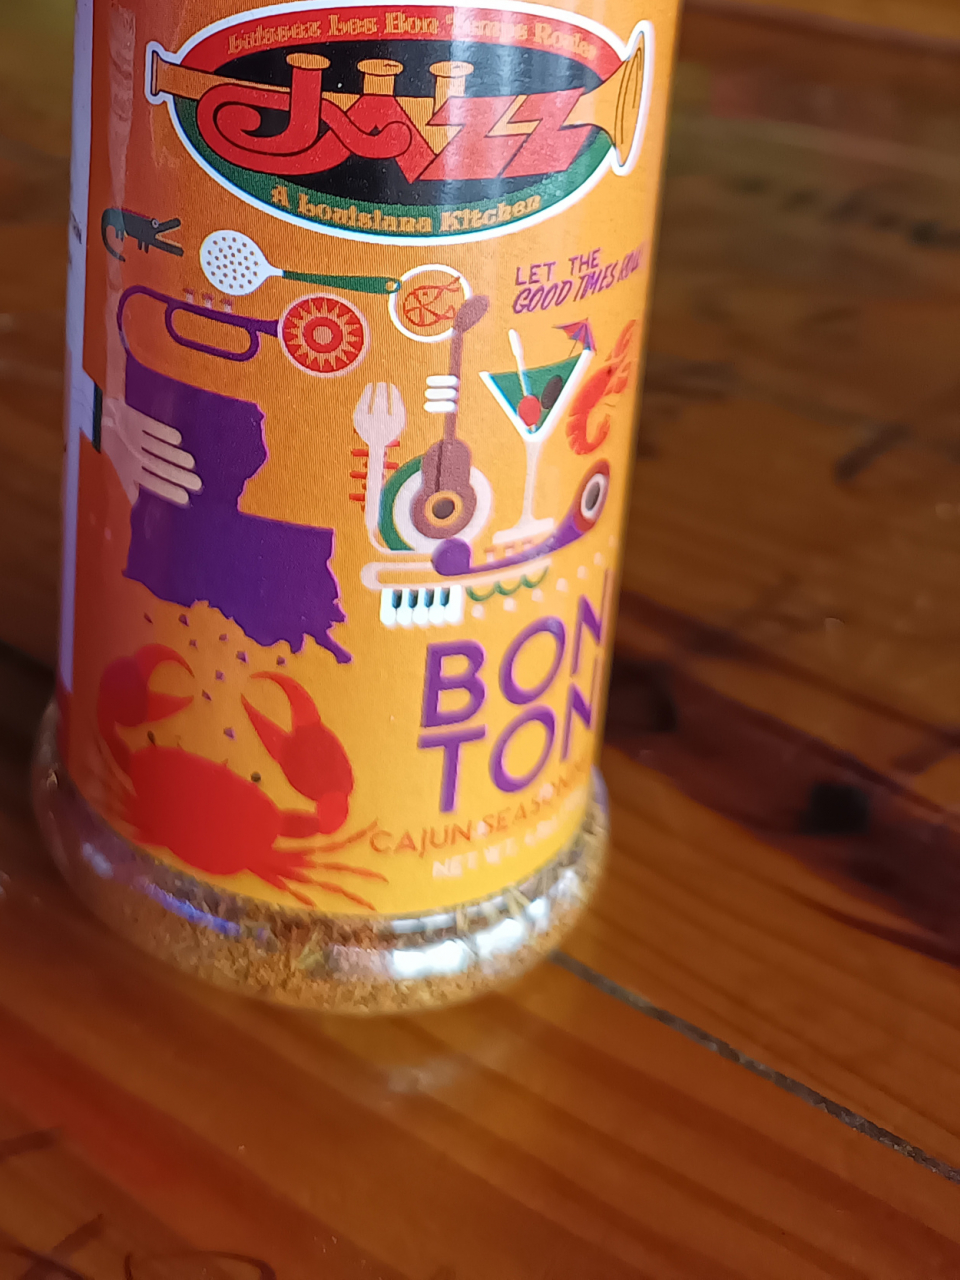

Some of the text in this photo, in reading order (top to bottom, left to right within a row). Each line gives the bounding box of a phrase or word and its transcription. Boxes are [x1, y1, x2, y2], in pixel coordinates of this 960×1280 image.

[445, 13, 529, 43] emps
[271, 185, 541, 233] A Louisiana Kitchen
[514, 247, 602, 286] LET THE
[512, 279, 573, 315] GOOD
[420, 568, 614, 729] BON
[417, 654, 604, 813] TON
[369, 818, 472, 858] CAJUN
[480, 760, 591, 834] SEASON
